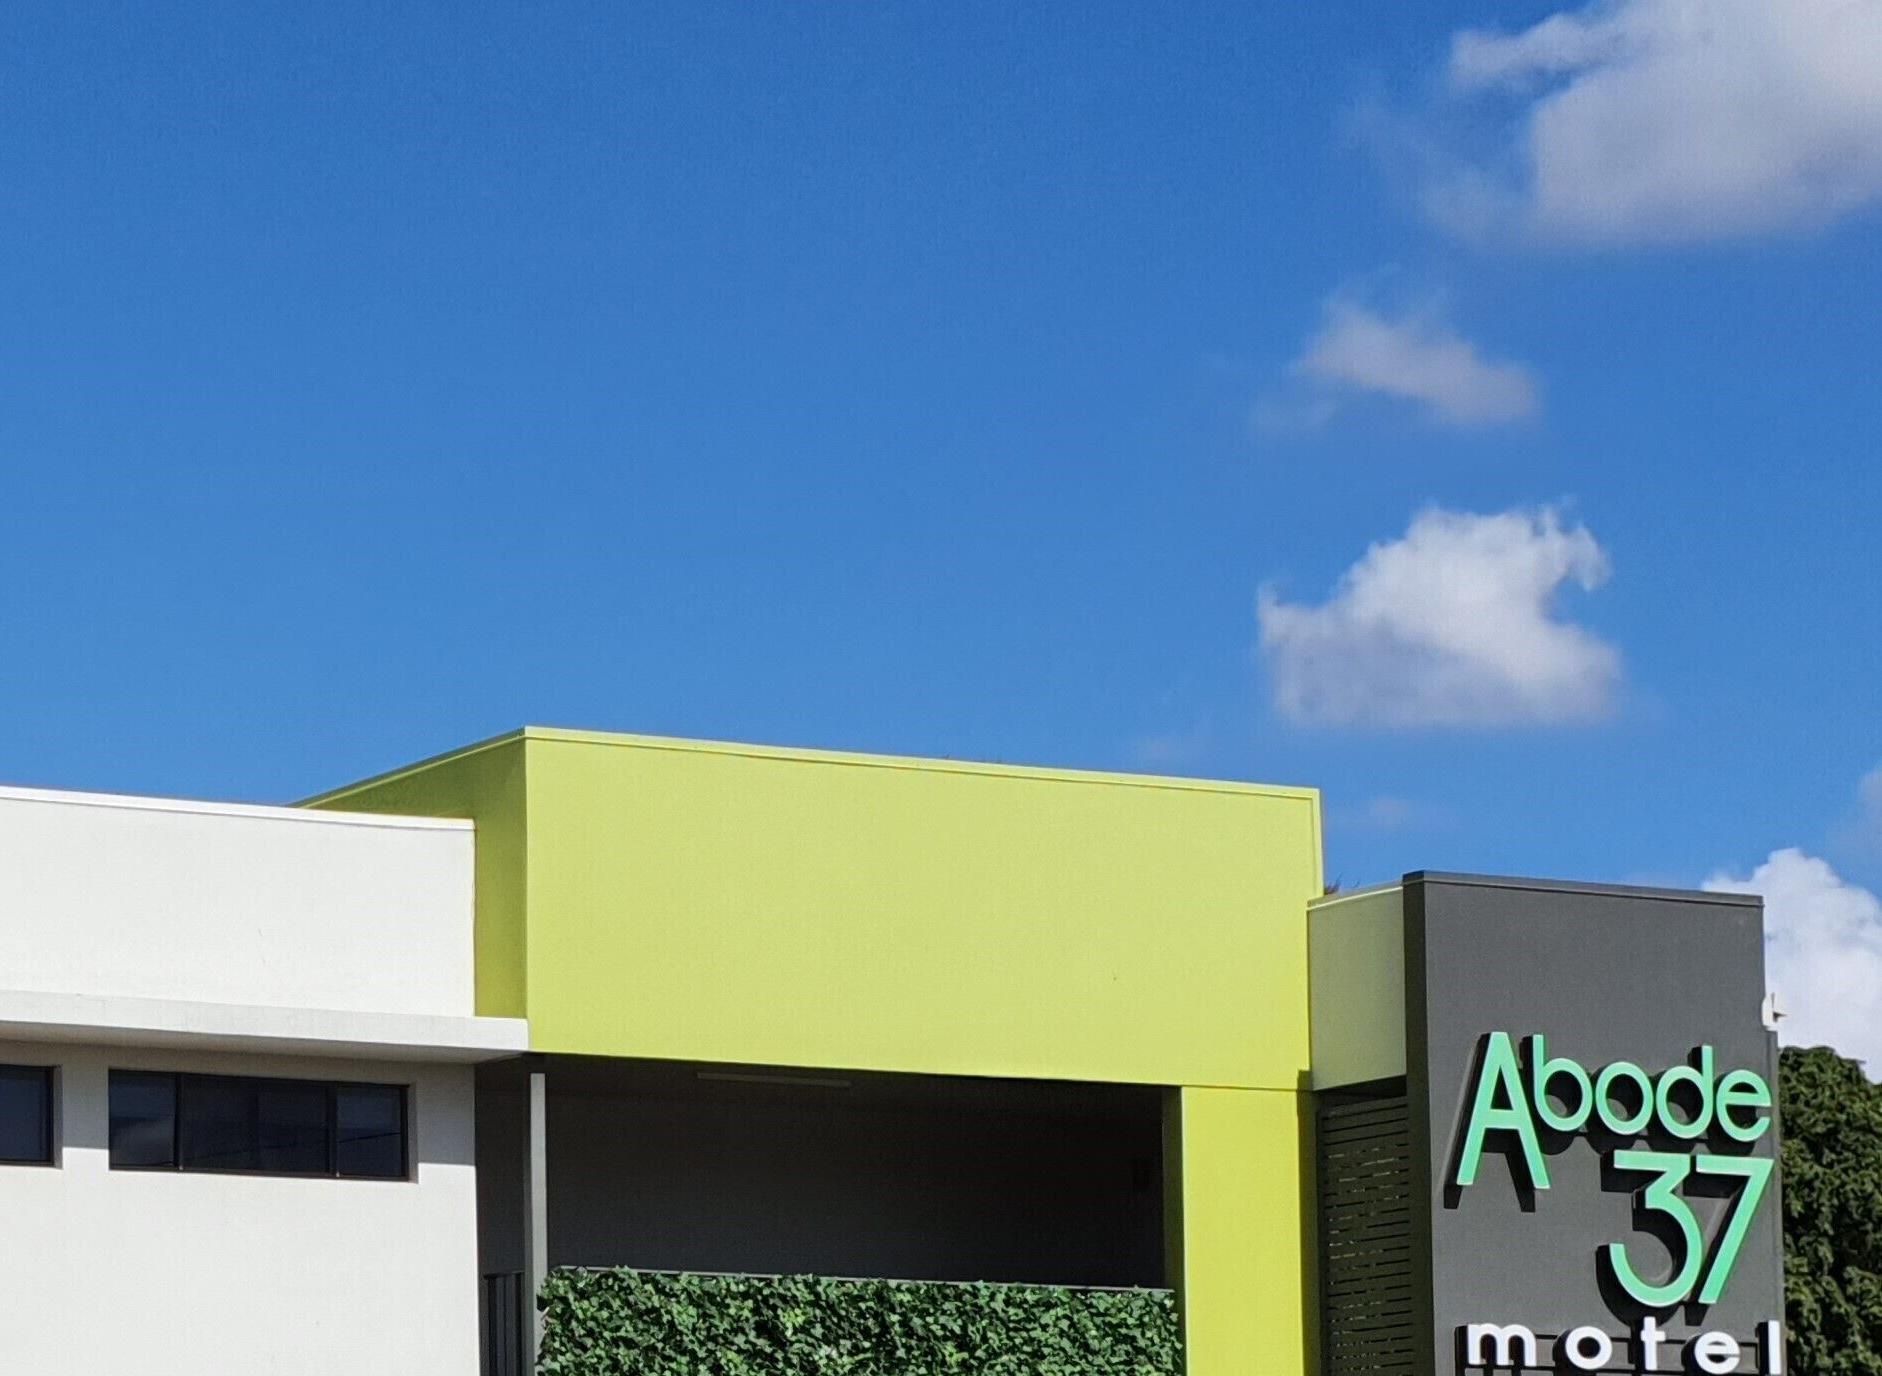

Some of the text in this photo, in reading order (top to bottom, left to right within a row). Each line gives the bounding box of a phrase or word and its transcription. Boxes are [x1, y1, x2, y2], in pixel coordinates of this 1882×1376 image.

[1456, 1031, 1773, 1190] Abode
[1608, 1149, 1775, 1308] 37
[1467, 1316, 1782, 1376] motel
